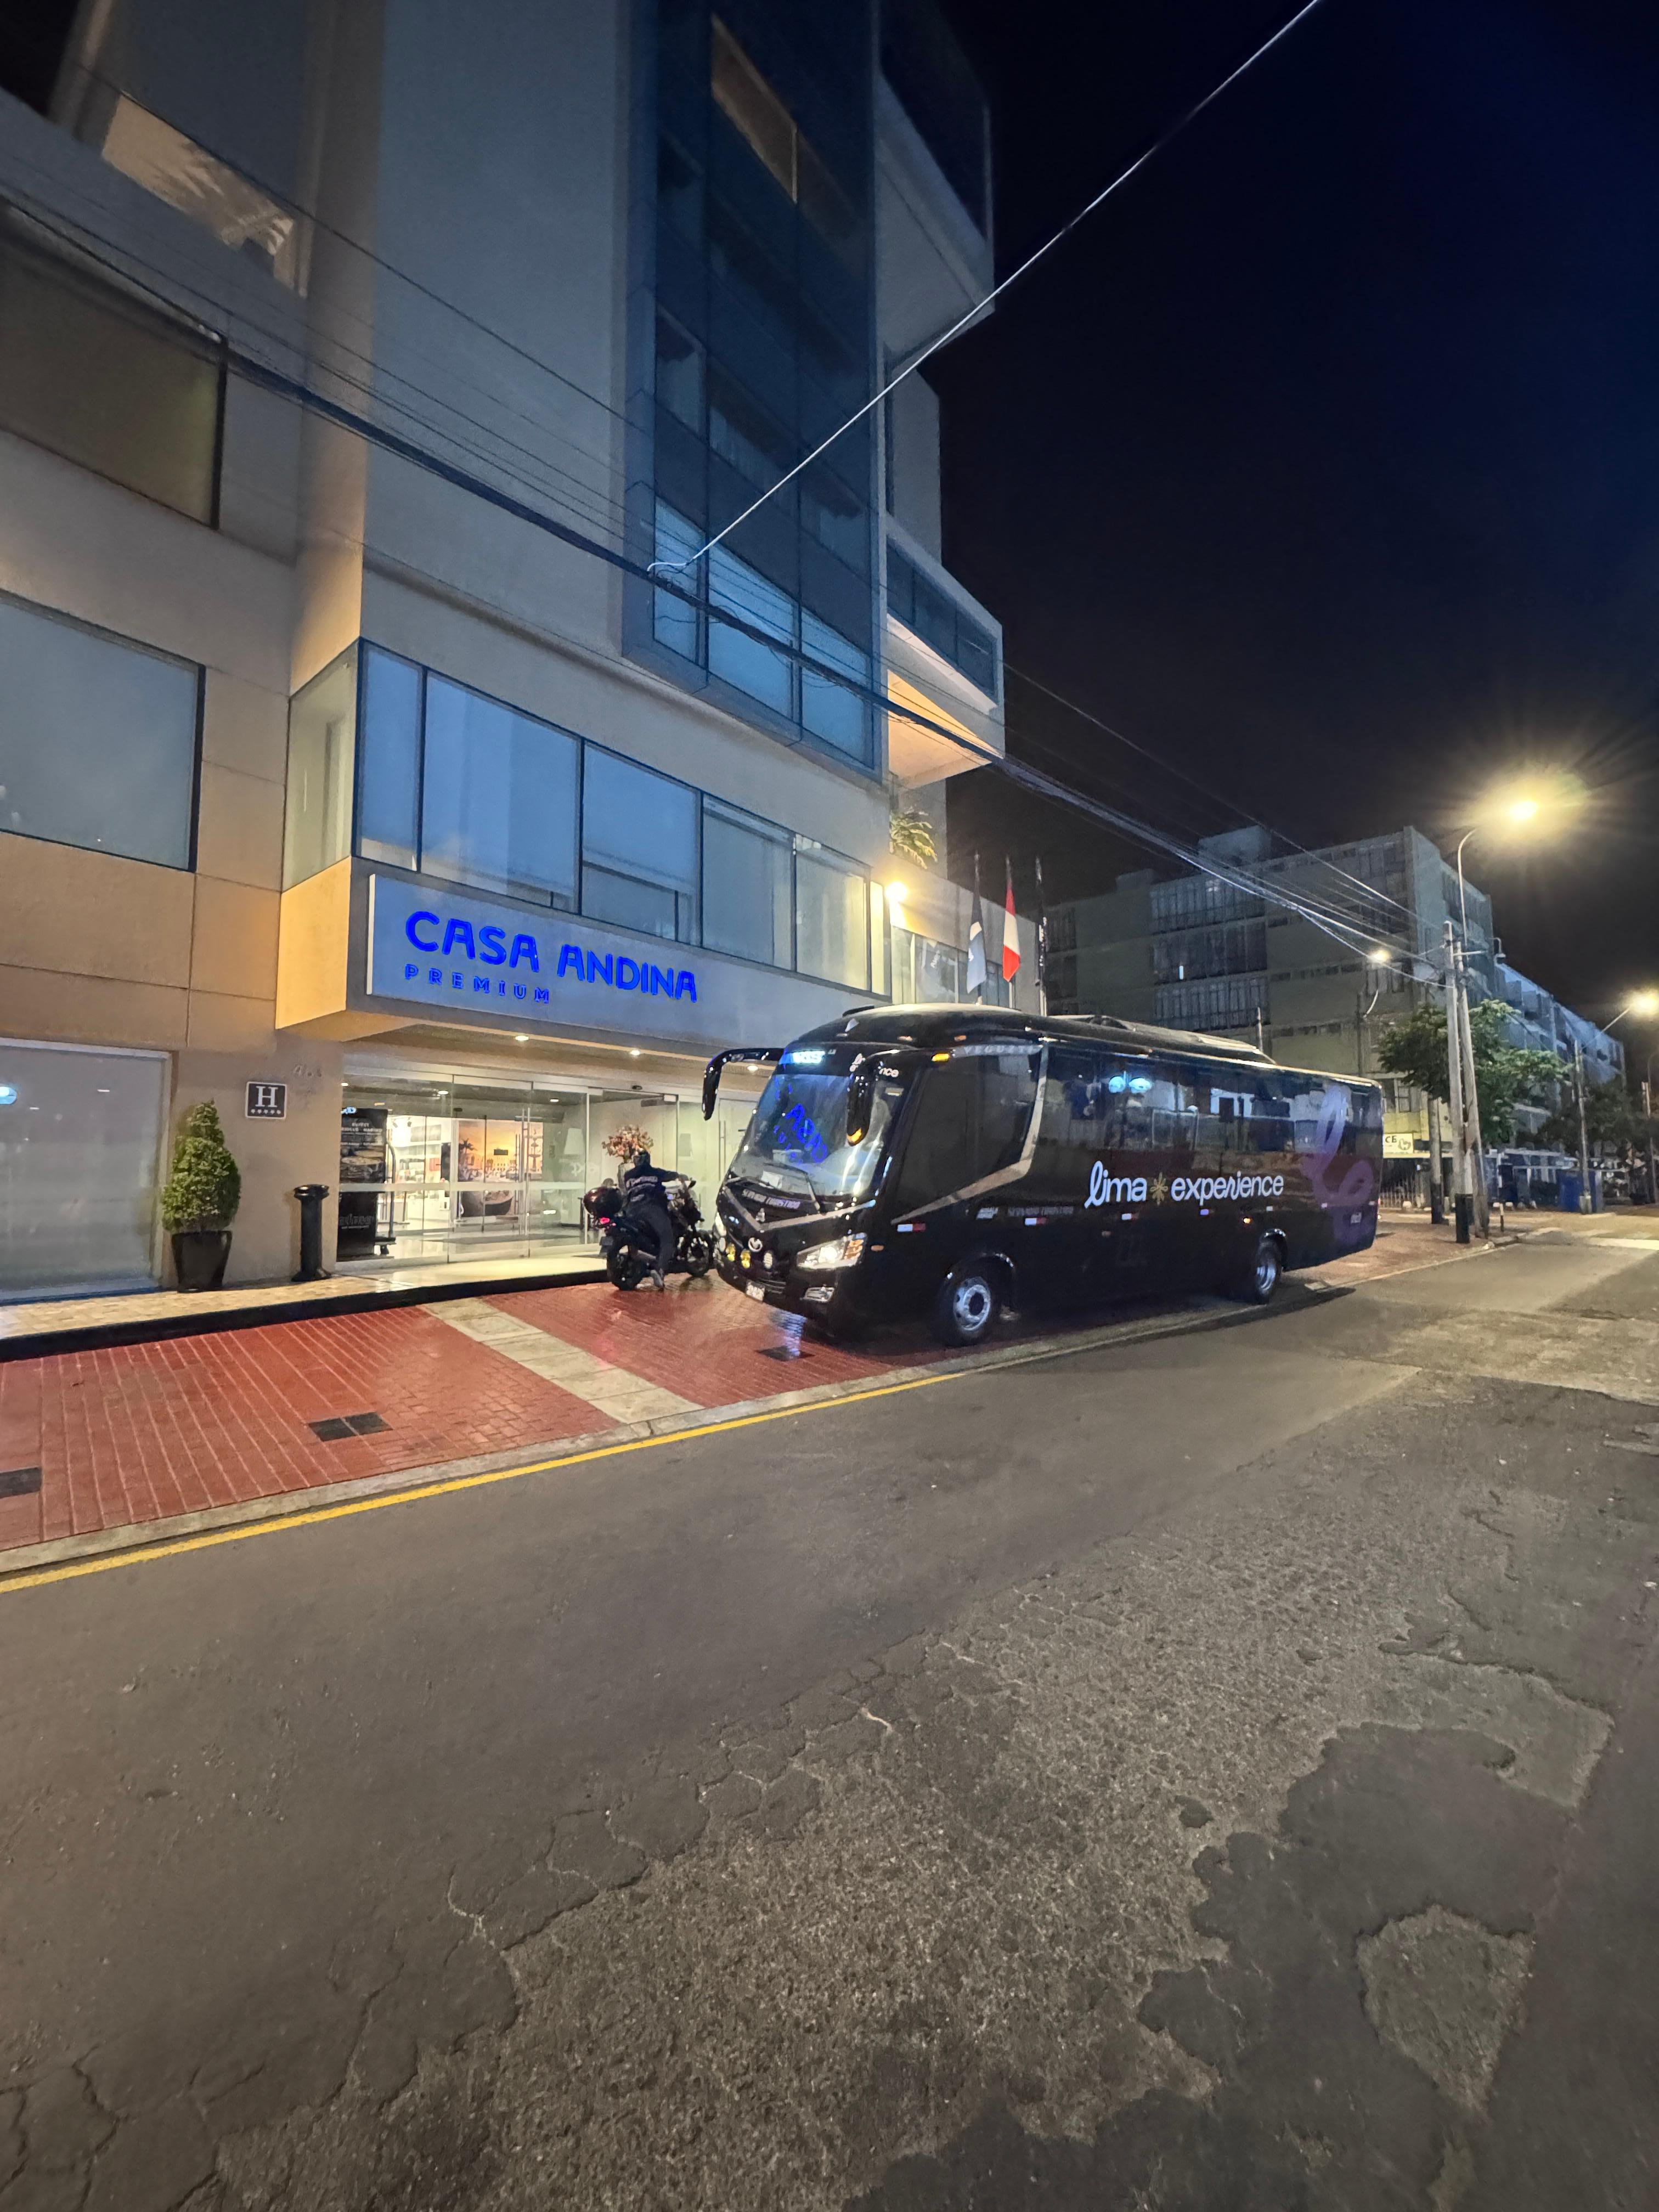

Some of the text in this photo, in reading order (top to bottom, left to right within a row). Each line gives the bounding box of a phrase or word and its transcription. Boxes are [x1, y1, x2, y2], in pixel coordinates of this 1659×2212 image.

[405, 911, 697, 1003] CASA ANDINA
[404, 963, 549, 1005] PREMIUM
[255, 1086, 279, 1108] H
[1084, 1160, 1284, 1208] lima experience
